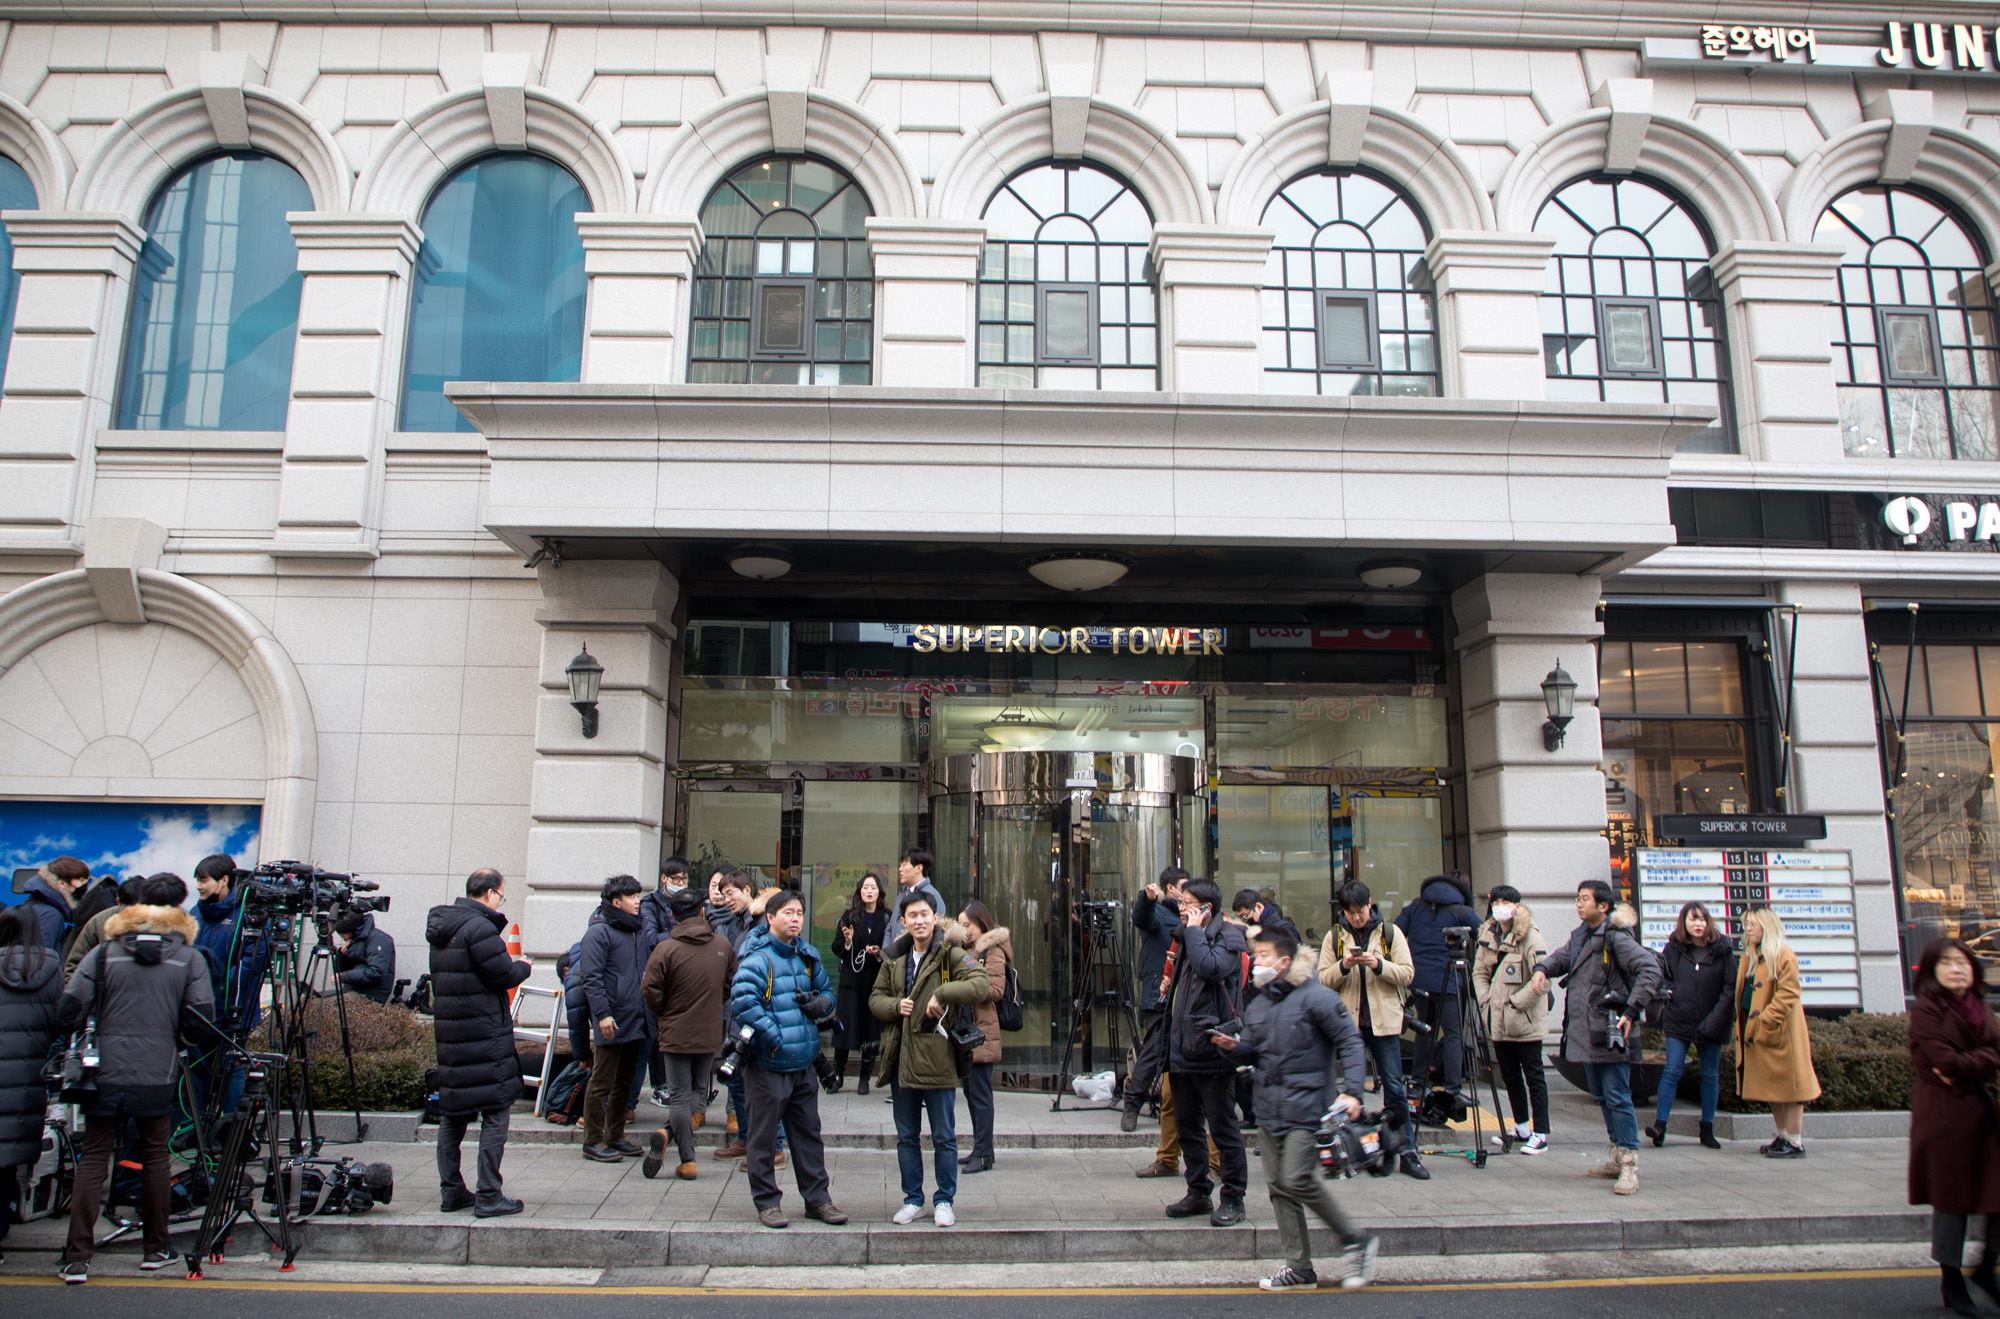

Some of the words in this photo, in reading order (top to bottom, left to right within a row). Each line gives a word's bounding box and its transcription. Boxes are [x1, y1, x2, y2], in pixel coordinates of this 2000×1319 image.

[1701, 24, 1817, 63] 준오헤어
[1877, 21, 2000, 70] JUN
[912, 625, 1092, 655] SUPERIOR
[1106, 627, 1224, 656] TOWER
[1700, 821, 1748, 832] SUPERIOR
[1751, 821, 1787, 832] TOWER
[1730, 854, 1741, 864] 15
[1749, 854, 1760, 864] 14
[1731, 871, 1742, 881] 13
[1750, 871, 1761, 881] 12
[1733, 888, 1744, 898] 11
[1751, 888, 1762, 898] 10
[1735, 905, 1742, 915] 9
[1736, 923, 1741, 932] 7
